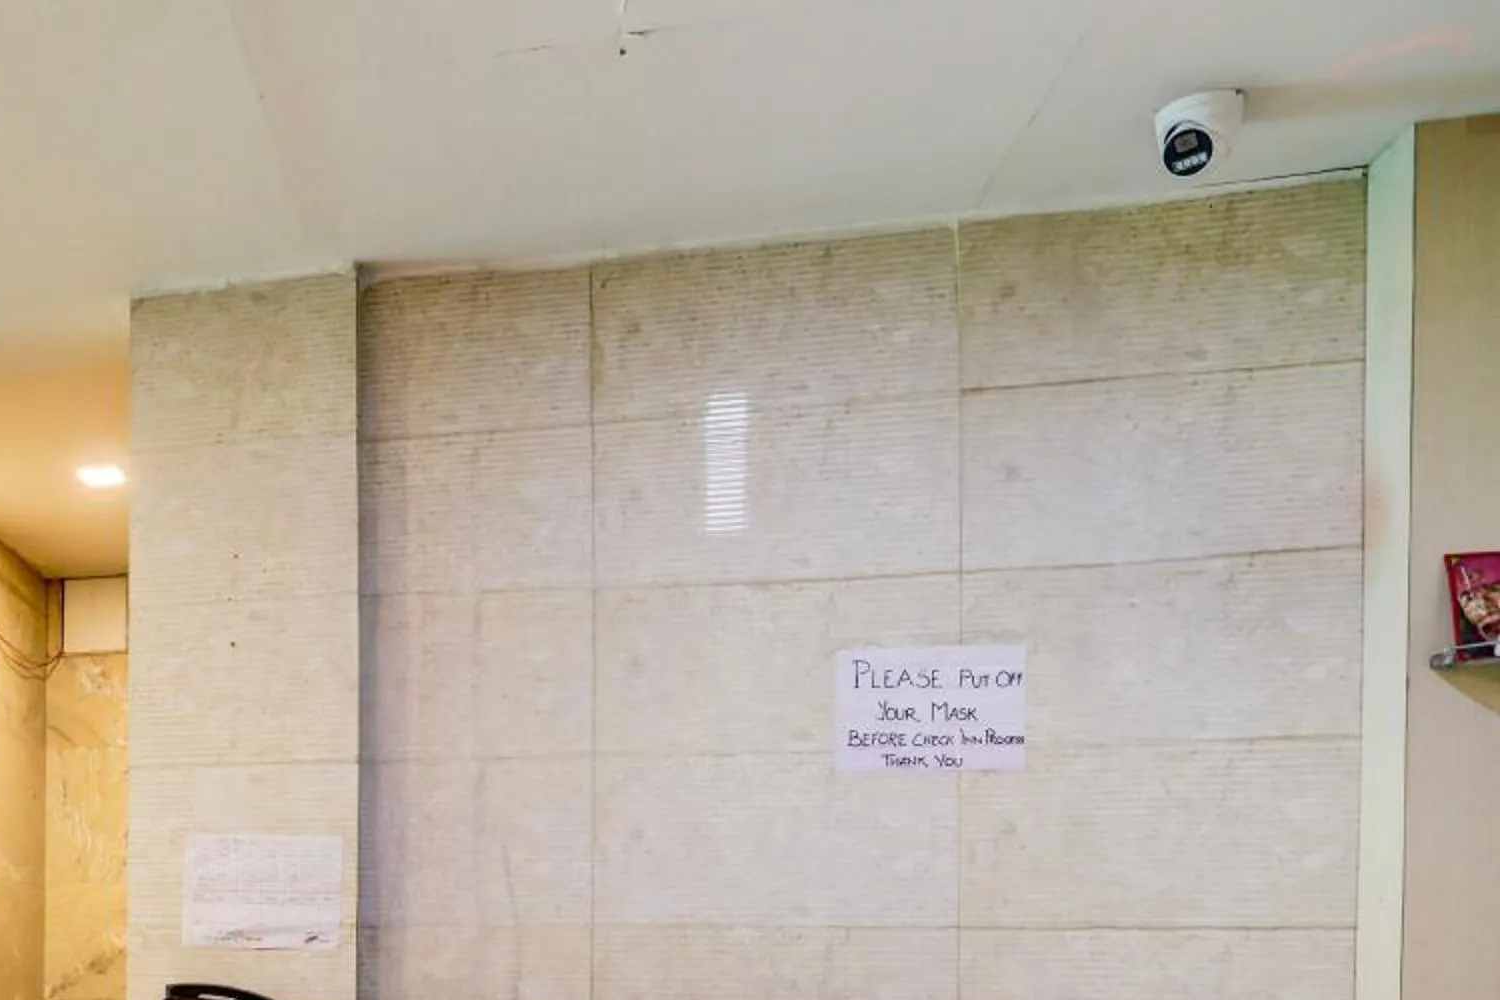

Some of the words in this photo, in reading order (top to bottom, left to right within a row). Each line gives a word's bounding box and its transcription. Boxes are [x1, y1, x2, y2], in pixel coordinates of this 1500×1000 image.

[852, 659, 943, 688] PLEASE
[959, 669, 989, 688] PUT
[876, 700, 921, 722] YOUR
[931, 702, 978, 722] MASK
[847, 729, 907, 748] BEFORE
[911, 732, 954, 747] CHECK
[882, 753, 928, 768] THANK
[934, 753, 963, 768] YOU
